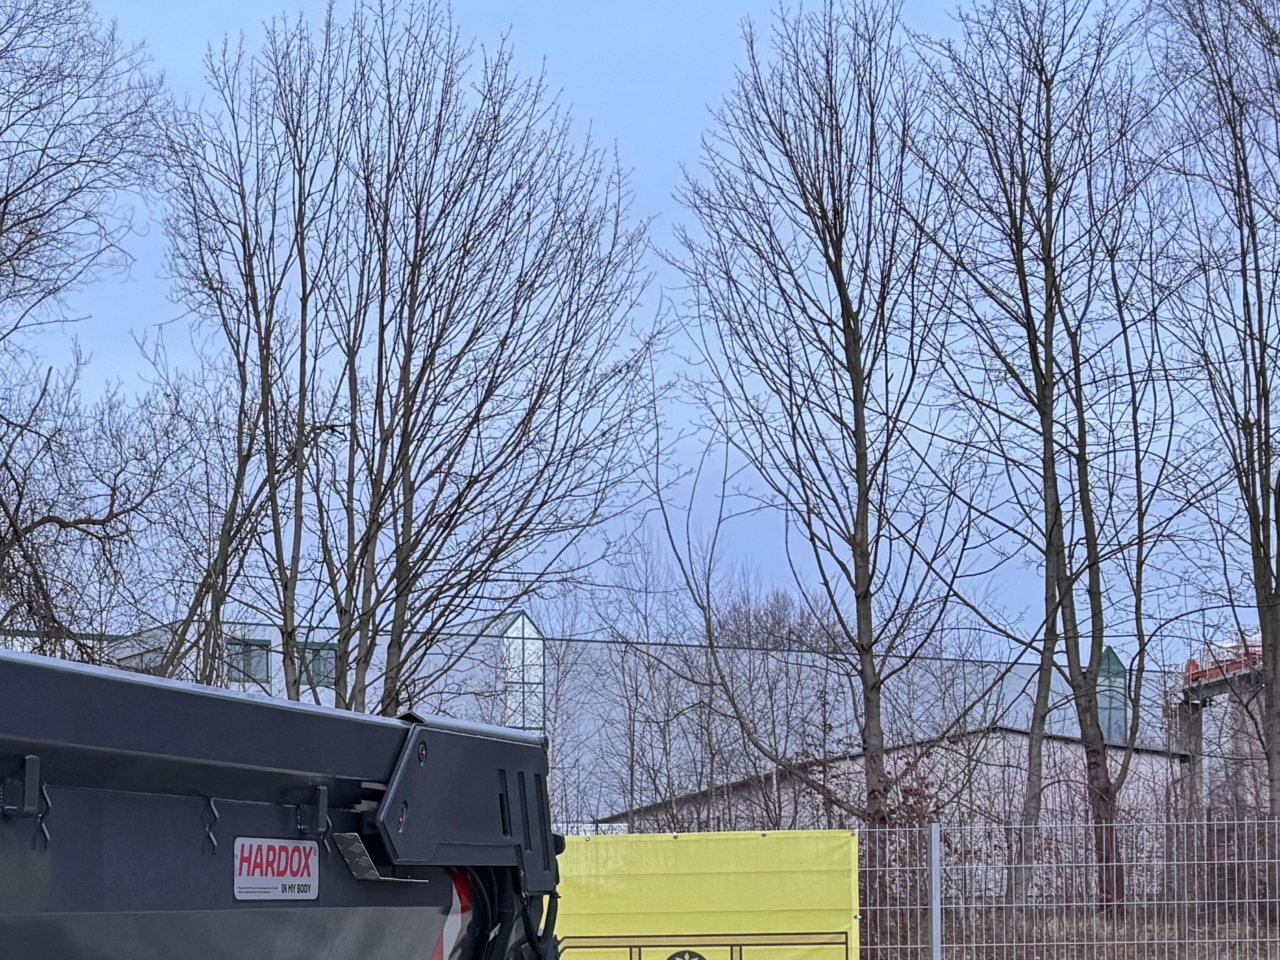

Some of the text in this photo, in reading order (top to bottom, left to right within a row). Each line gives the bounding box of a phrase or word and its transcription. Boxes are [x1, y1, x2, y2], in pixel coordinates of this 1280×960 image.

[238, 843, 313, 878] HARDOX
[281, 883, 288, 894] IN
[288, 883, 297, 894] MY
[297, 883, 312, 894] BODY
